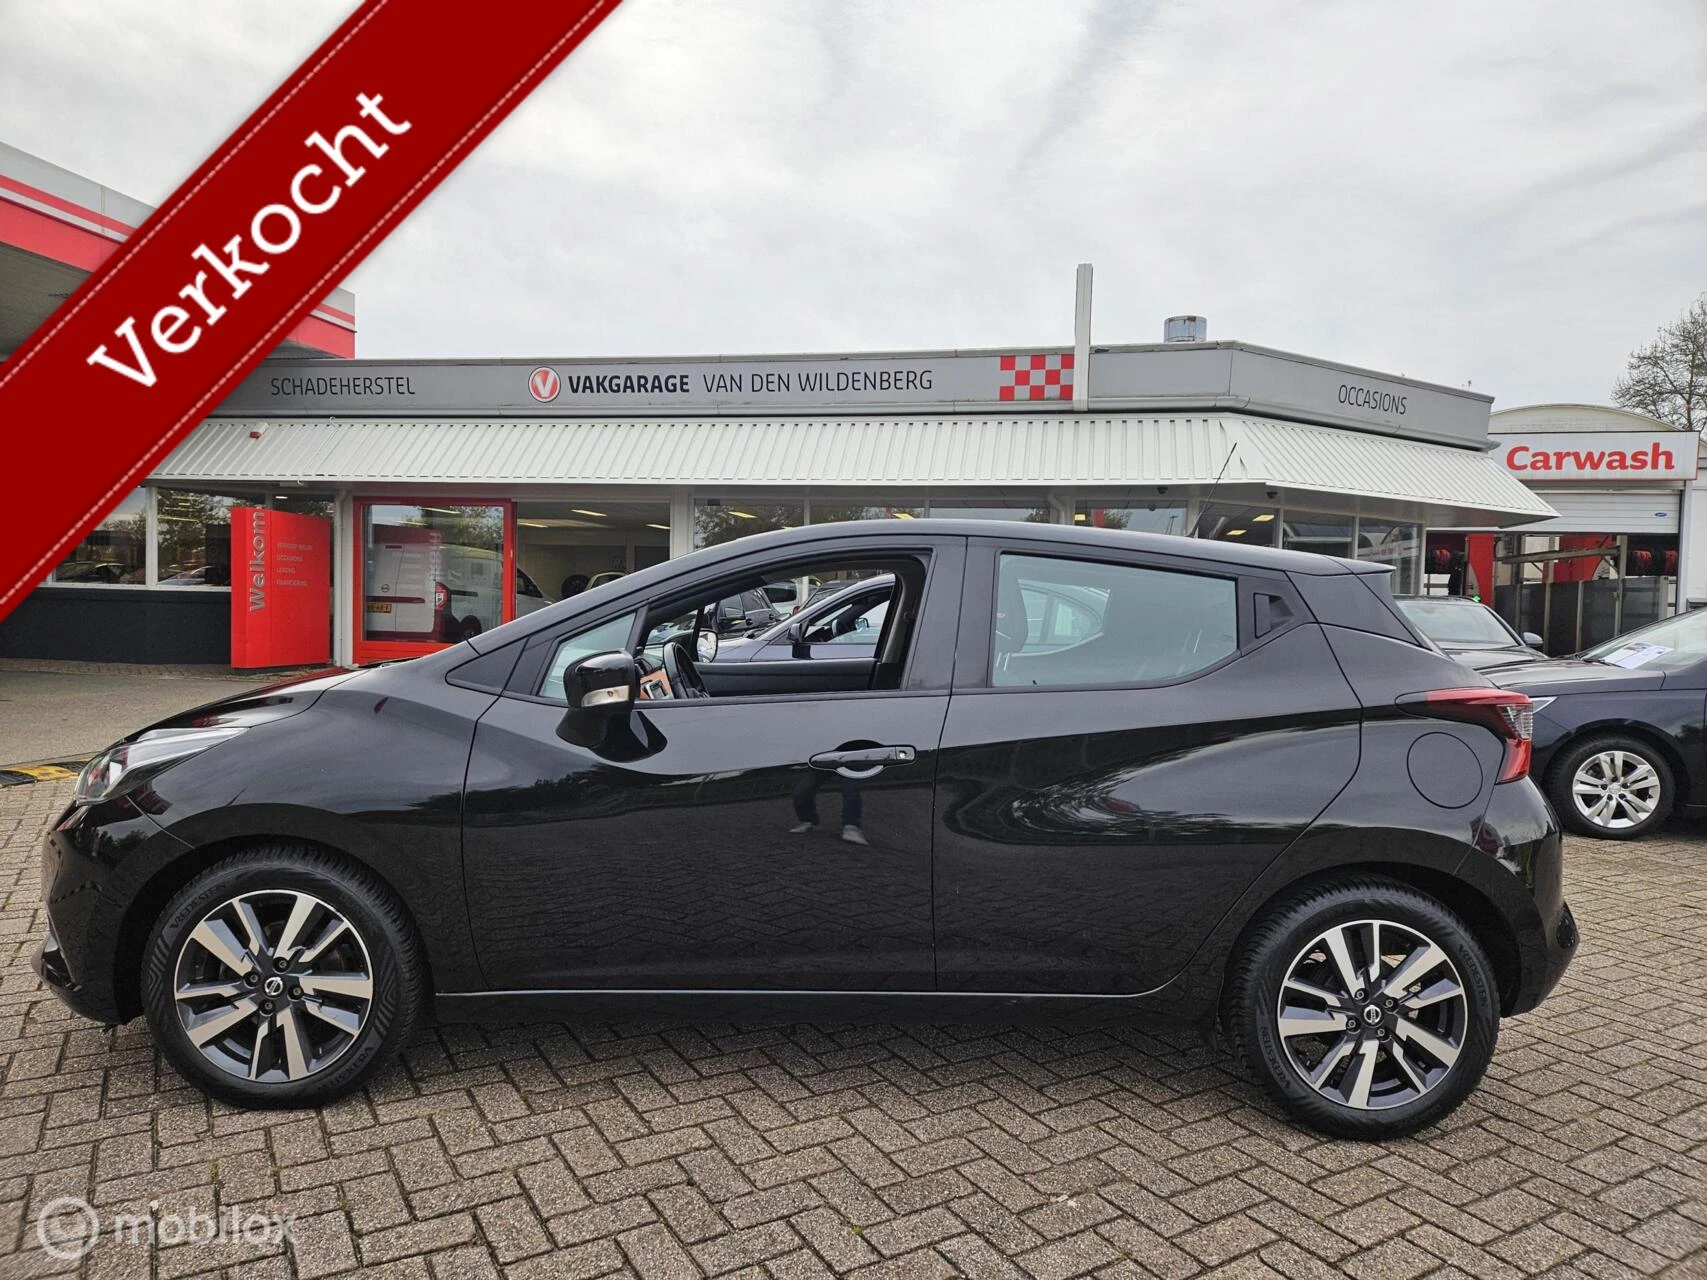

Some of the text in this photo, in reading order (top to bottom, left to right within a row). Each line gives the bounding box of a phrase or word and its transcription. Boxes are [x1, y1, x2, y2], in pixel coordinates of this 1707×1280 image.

[270, 376, 416, 396] SCHADEHERSTEL
[568, 374, 690, 394] VAKGARAGE
[703, 373, 742, 393] VAN
[751, 373, 790, 393] DEN
[798, 370, 933, 393] WILDENBERG
[1338, 384, 1407, 415] OCCASIONS
[1506, 442, 1675, 470] Carwash
[249, 511, 266, 613] Welkom
